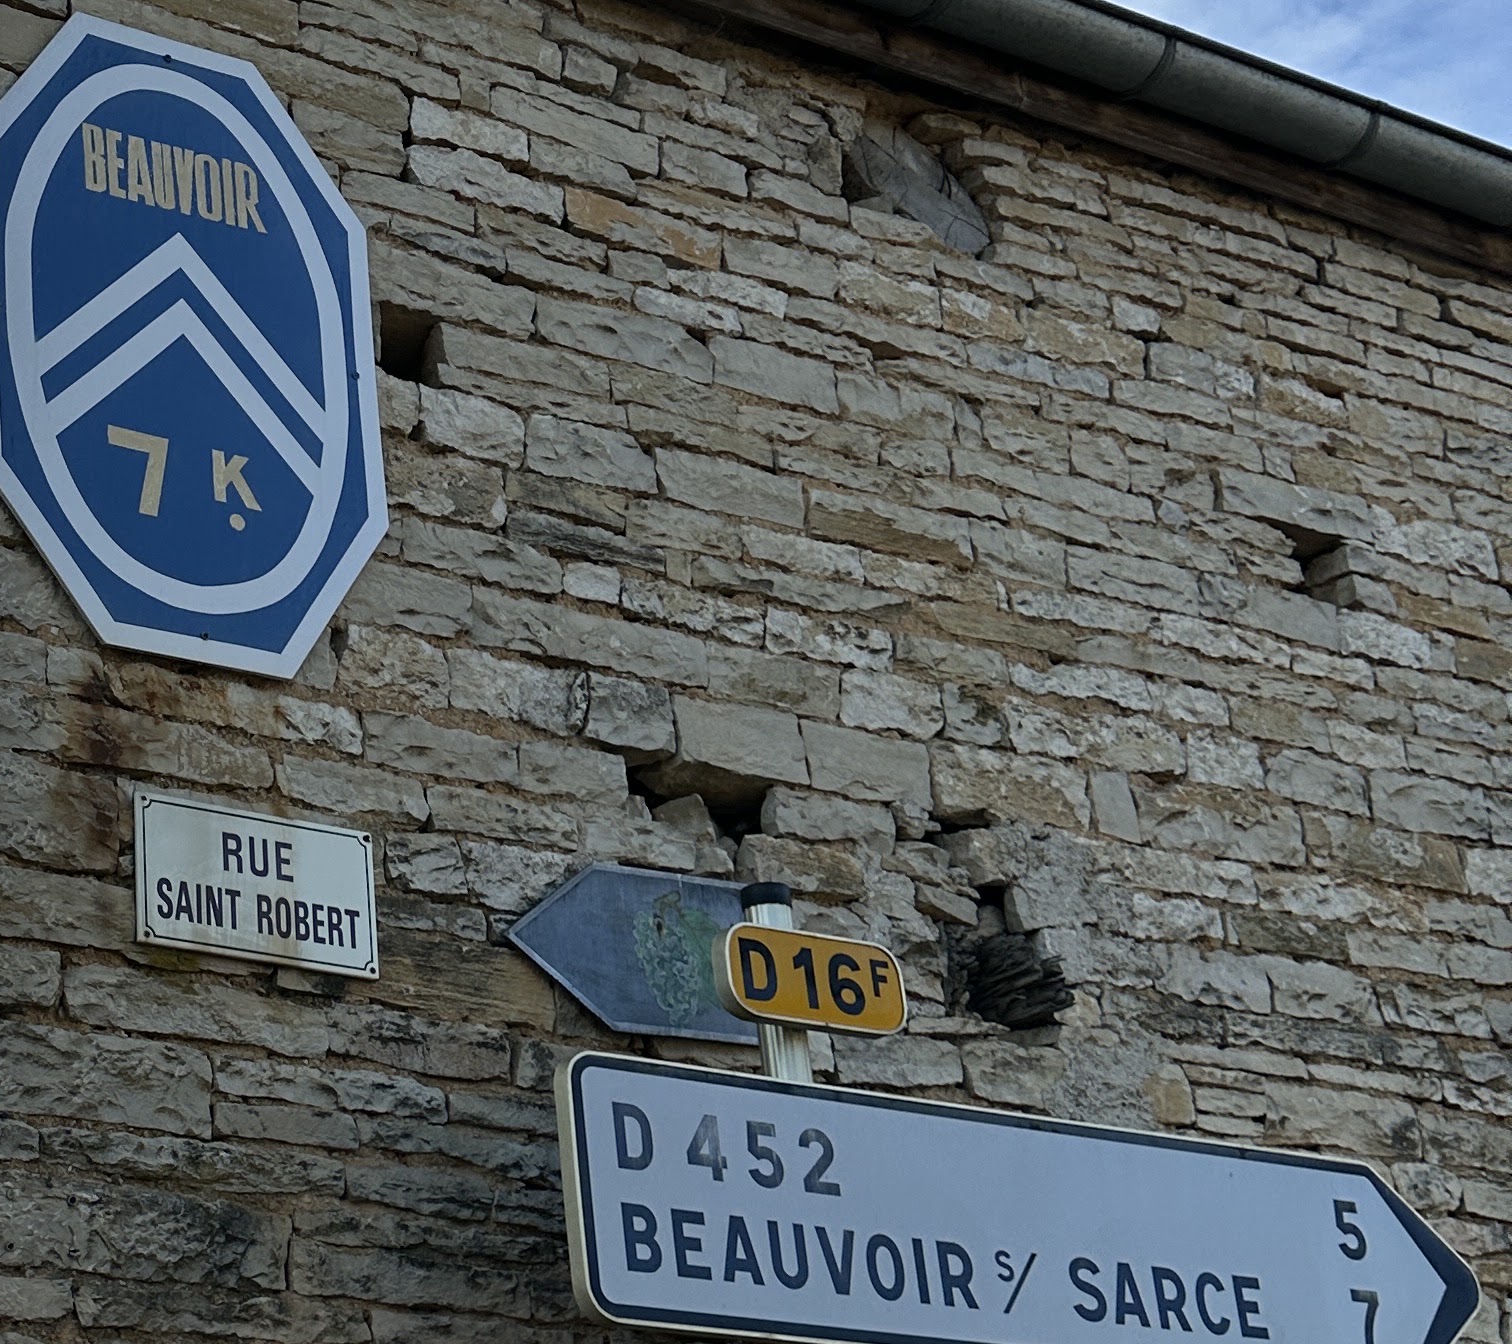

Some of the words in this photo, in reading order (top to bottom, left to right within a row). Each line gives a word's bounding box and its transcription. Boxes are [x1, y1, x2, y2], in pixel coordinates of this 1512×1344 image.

[82, 122, 268, 233] BEAUVOIR
[107, 425, 169, 517] 7
[222, 832, 294, 883] RUE
[156, 877, 241, 930] SAINT
[256, 894, 360, 948] ROBERT
[611, 1101, 654, 1171] D
[686, 1114, 841, 1197] 452
[1332, 1199, 1367, 1260] 5
[620, 1202, 980, 1310] BEAUVOIR
[1068, 1257, 1270, 1340] SARCE
